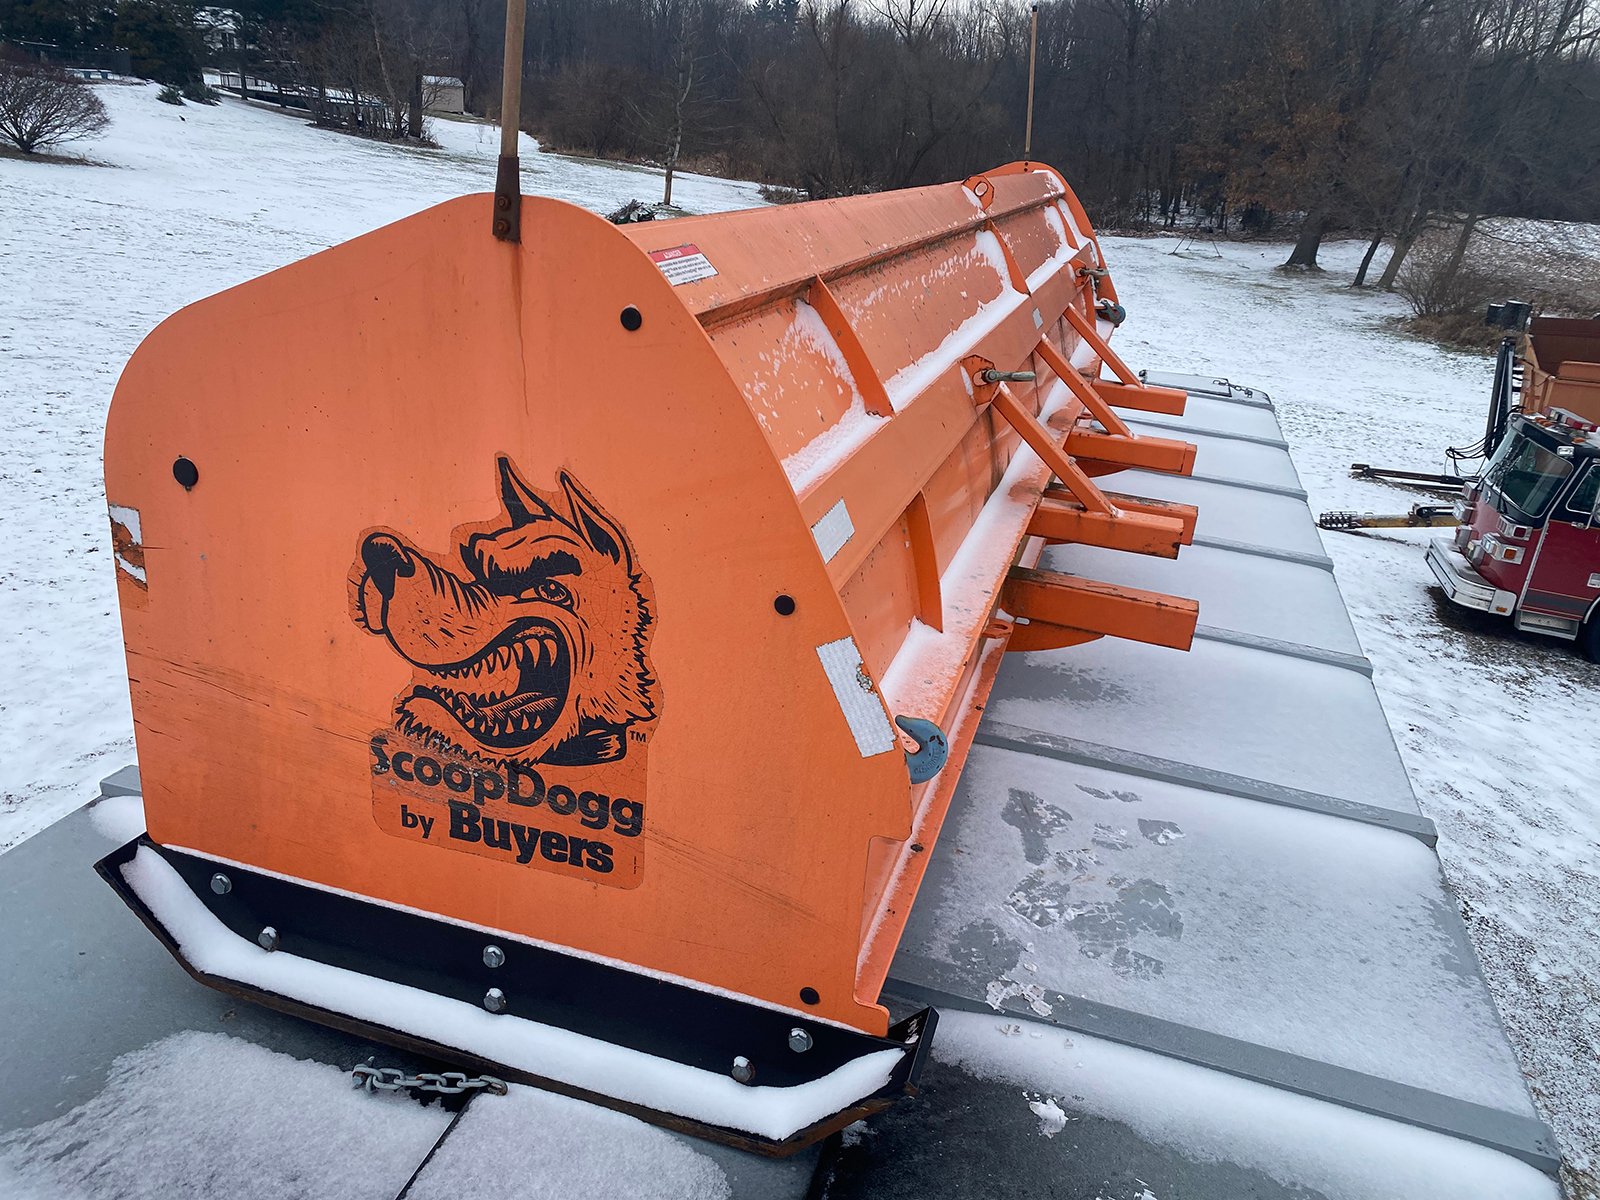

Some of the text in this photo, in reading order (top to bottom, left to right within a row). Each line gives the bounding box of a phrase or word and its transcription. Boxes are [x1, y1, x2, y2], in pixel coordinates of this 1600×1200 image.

[629, 730, 647, 743] TM
[370, 735, 644, 837] ScoopDogg
[401, 799, 614, 873] by Buyers
